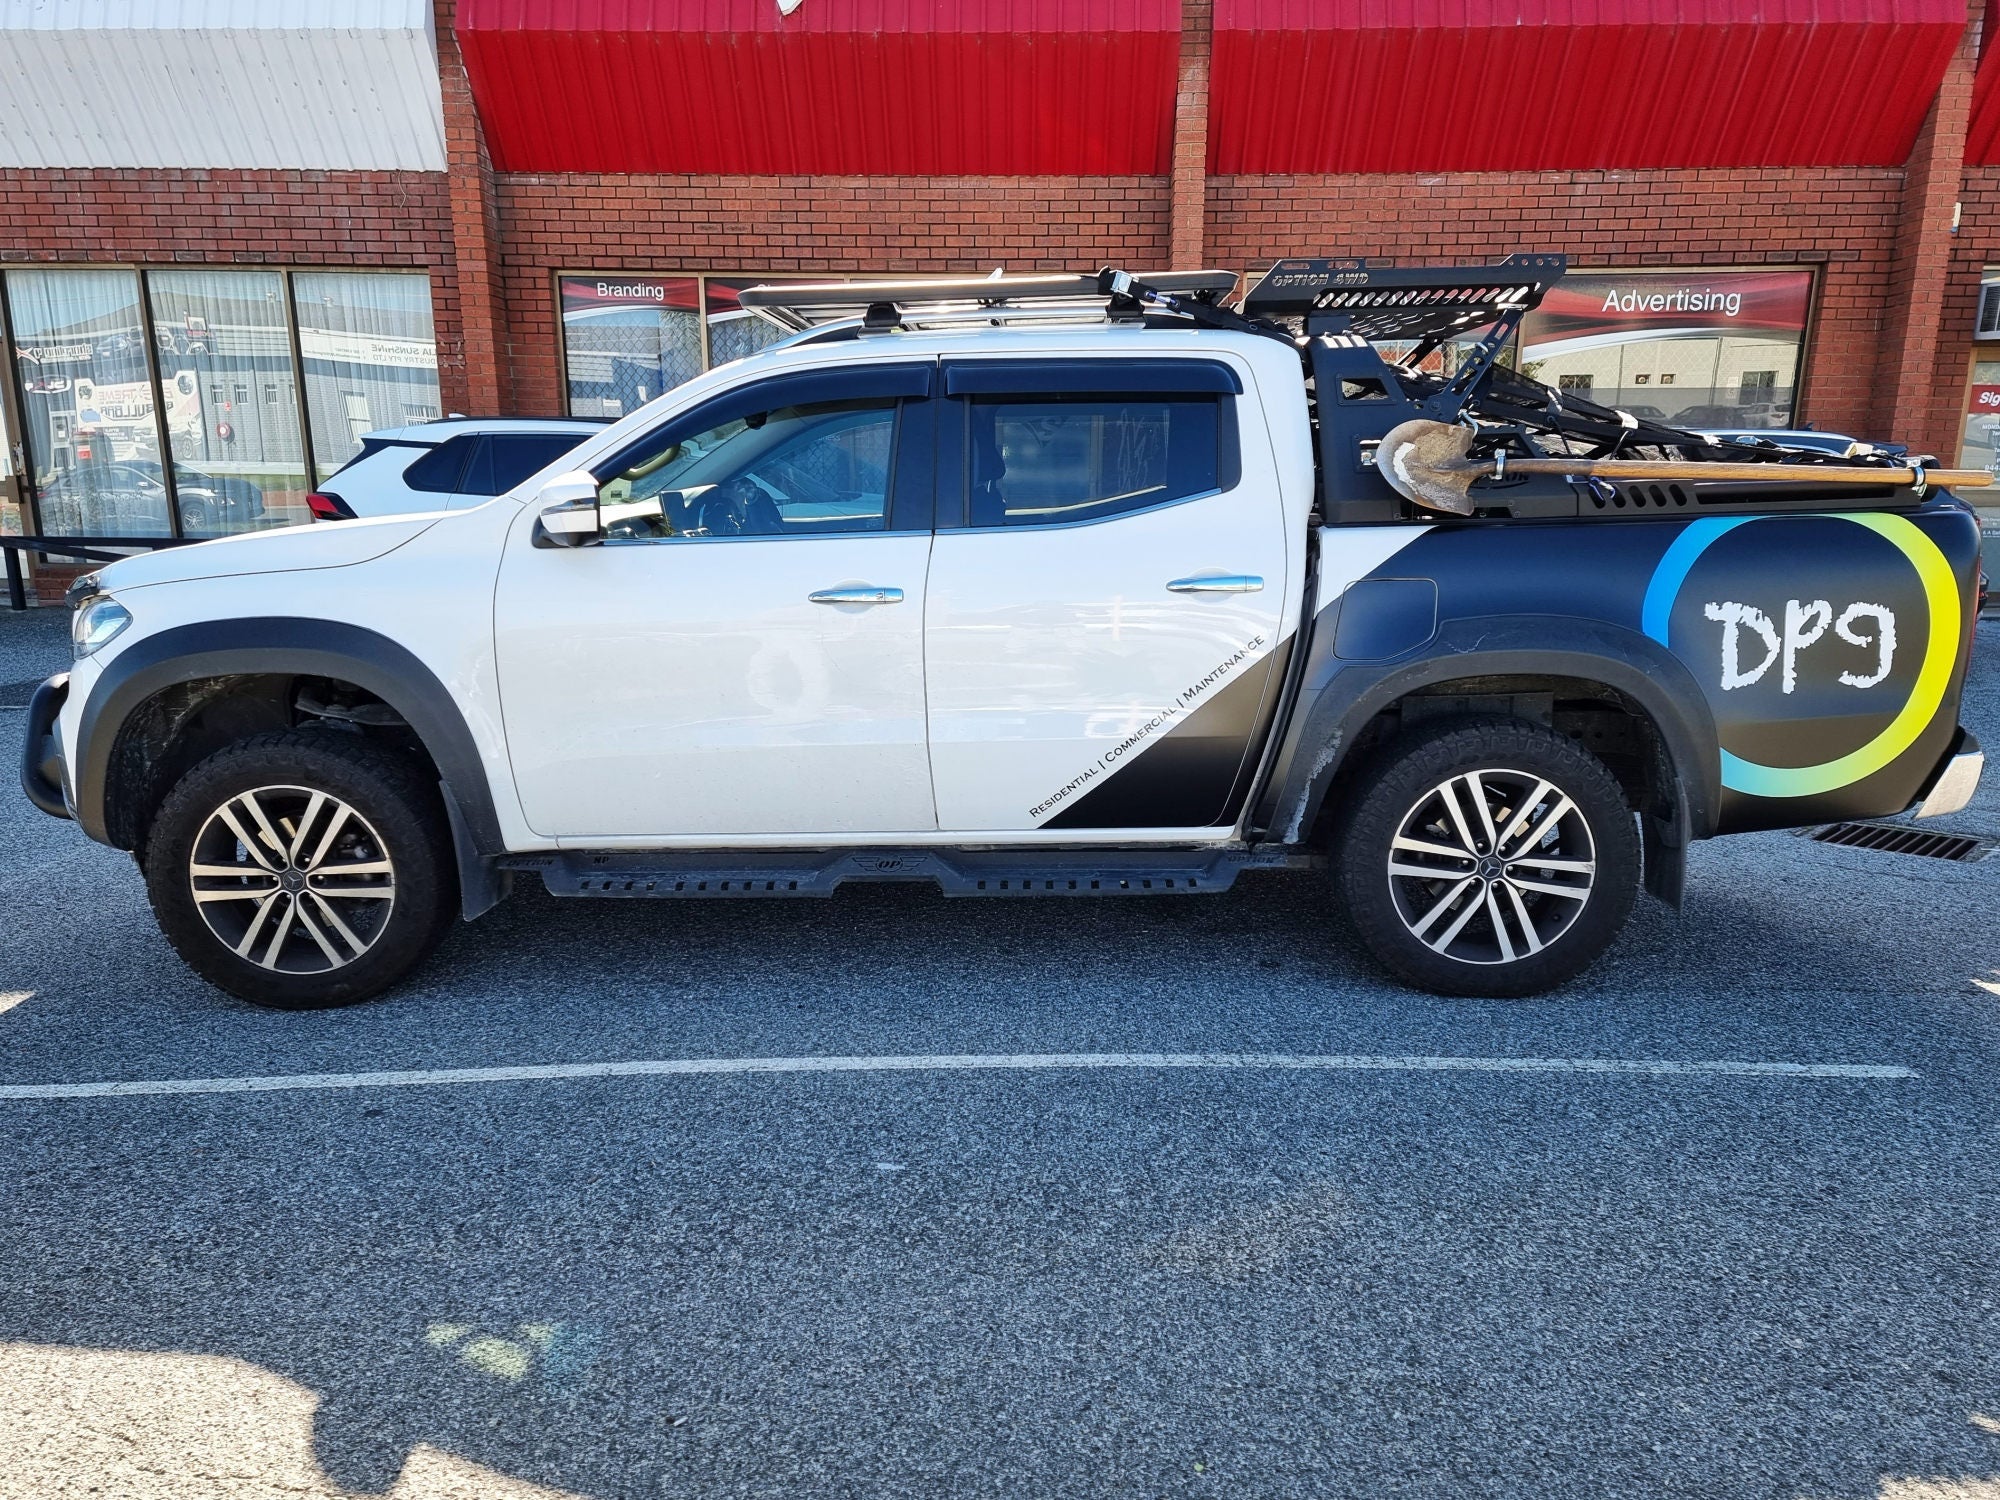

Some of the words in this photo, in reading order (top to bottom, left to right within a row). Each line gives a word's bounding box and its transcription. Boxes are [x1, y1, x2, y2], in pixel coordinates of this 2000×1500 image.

[1272, 273, 1329, 287] OPTION
[1333, 272, 1369, 285] 4WD
[597, 282, 664, 301] Branding
[1601, 288, 1741, 317] Advertising
[1979, 391, 2000, 406] Sig
[1028, 768, 1098, 818] RESIDENTIAL
[1104, 707, 1177, 762] COMMERCIAL
[1182, 635, 1265, 702] MAINTENANCE
